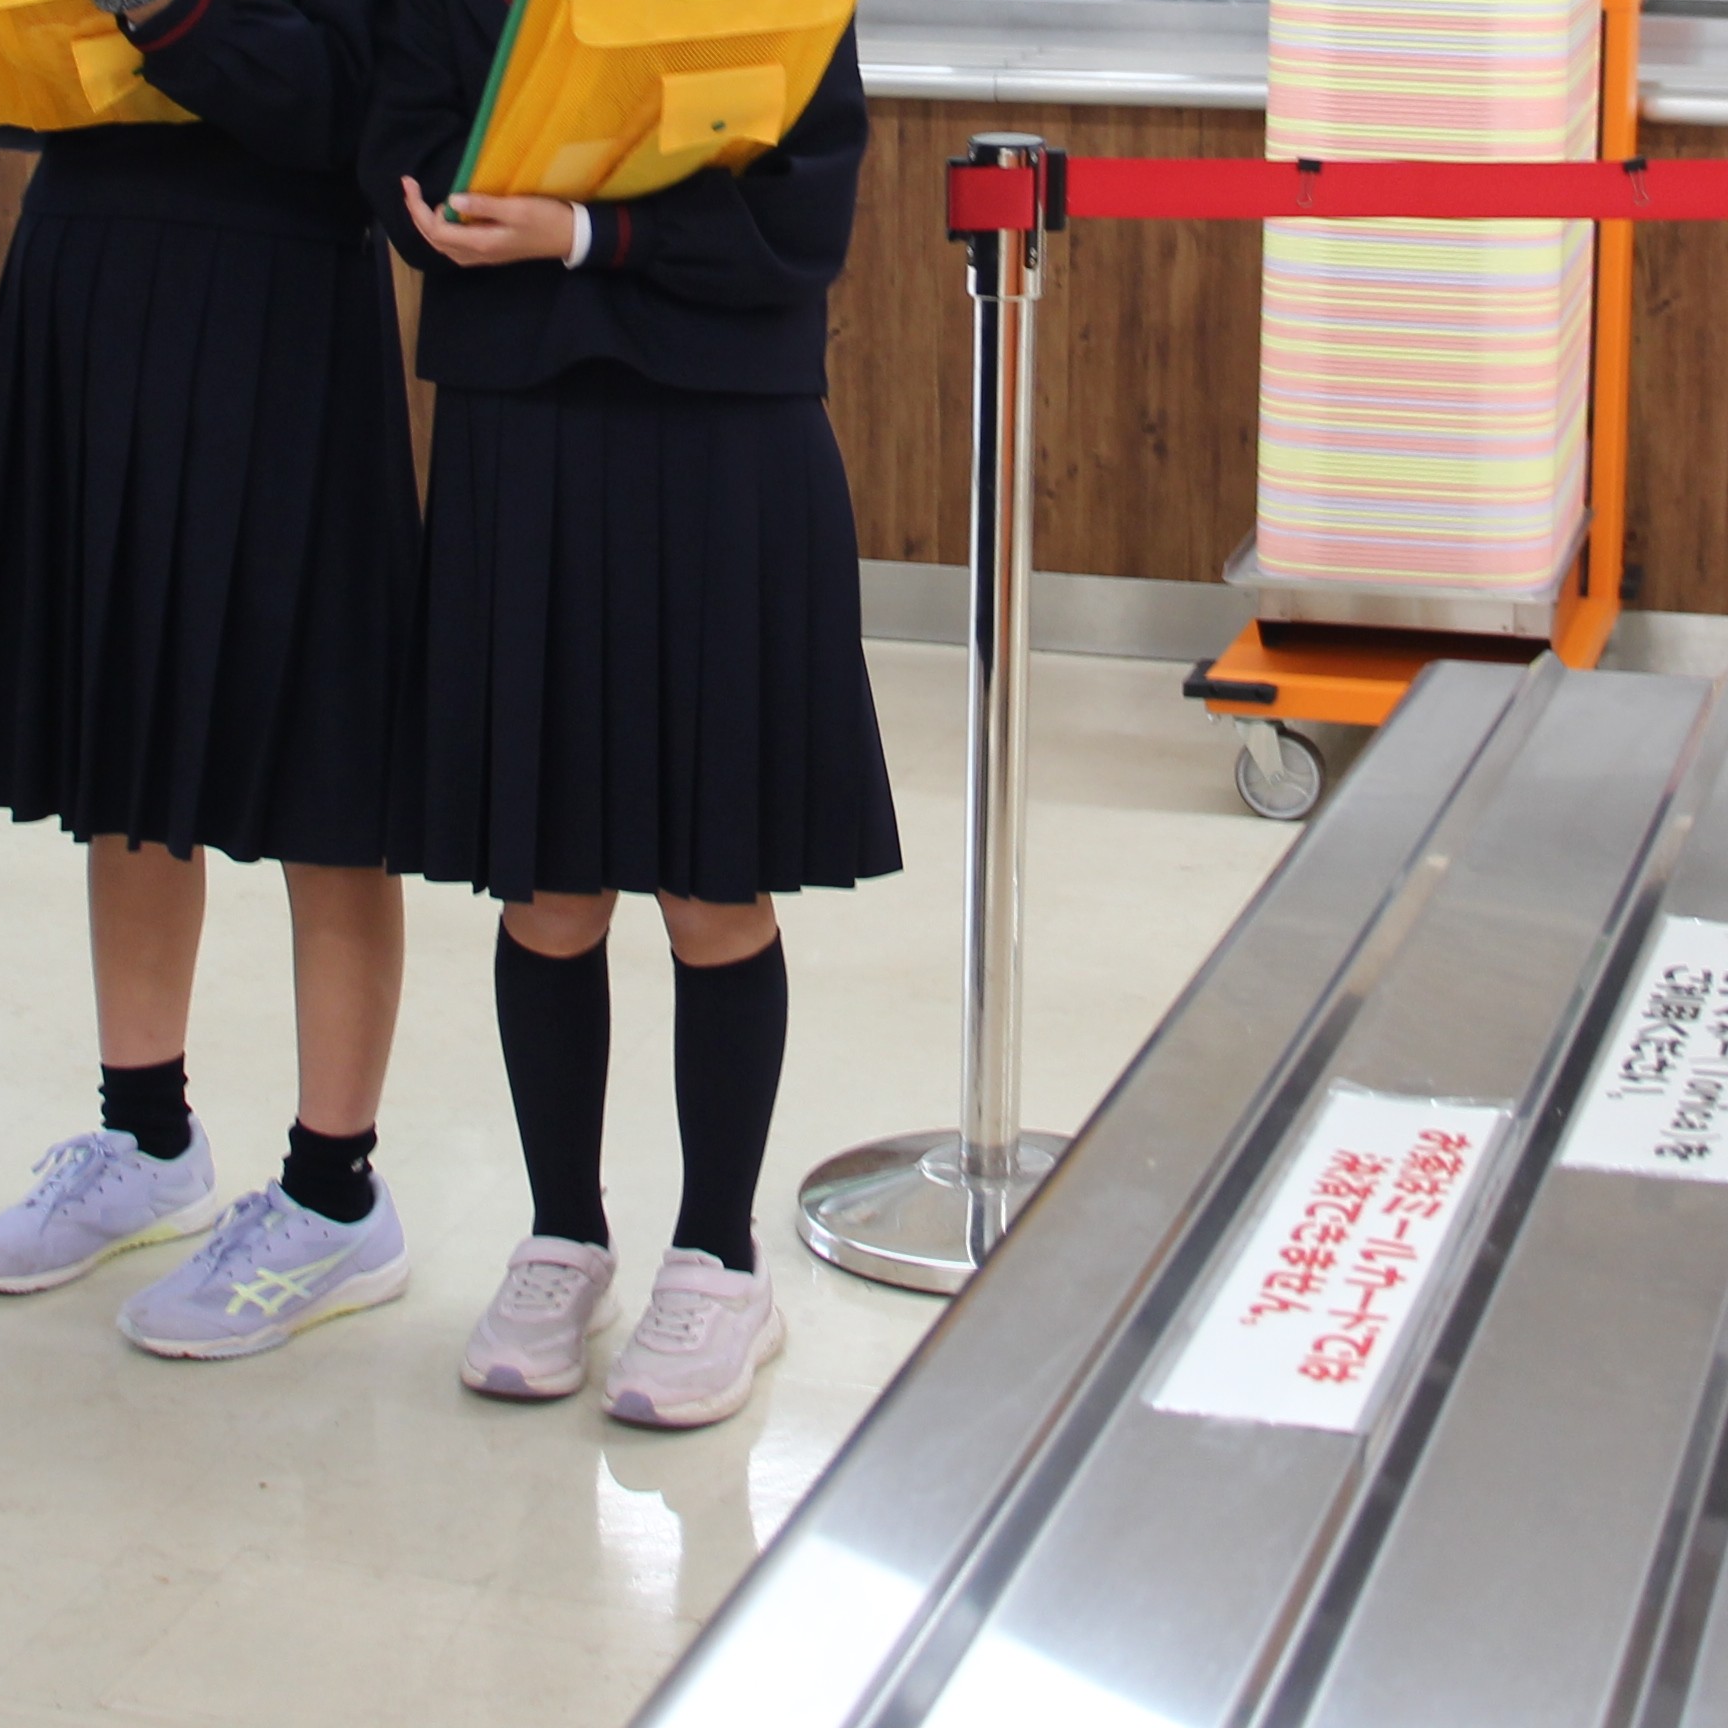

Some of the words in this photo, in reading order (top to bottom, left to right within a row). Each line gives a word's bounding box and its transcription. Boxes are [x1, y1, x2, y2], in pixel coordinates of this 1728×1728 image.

[1606, 964, 1713, 1100] ご利用ください。
[1239, 1149, 1393, 1327] 決済できません。
